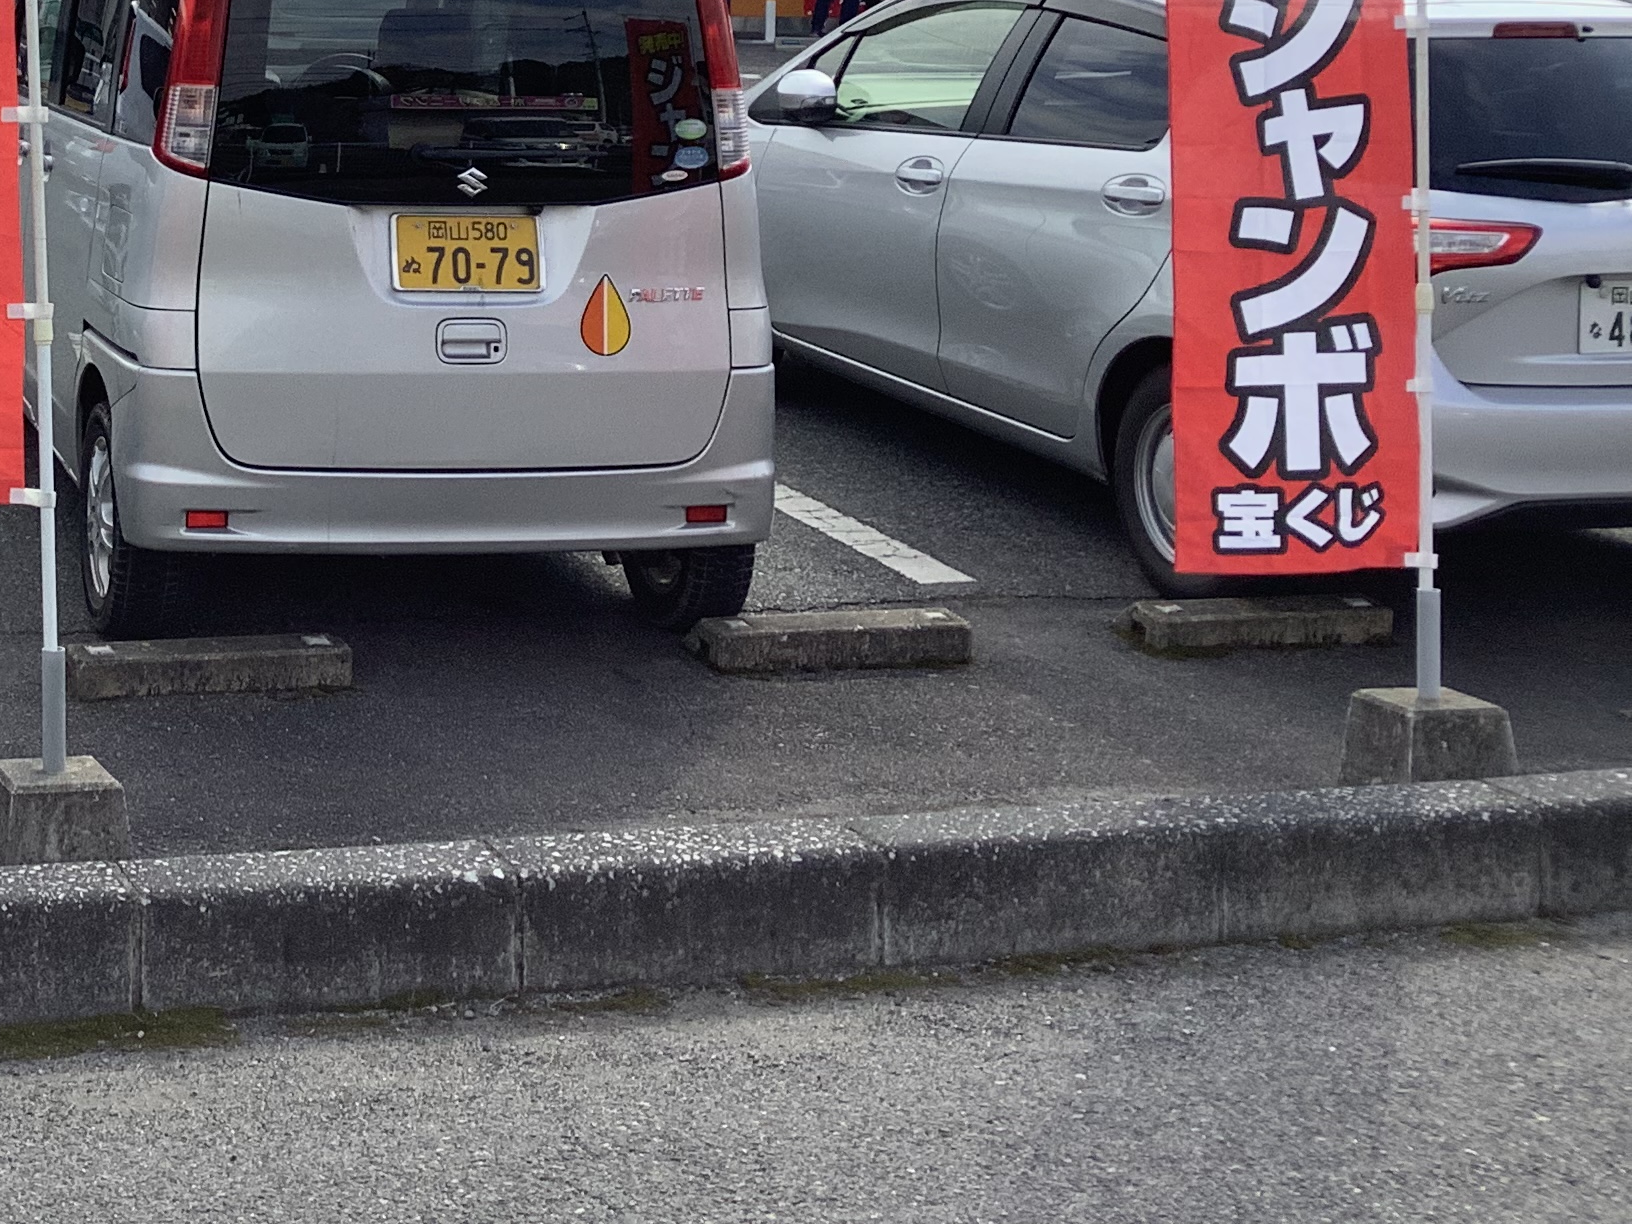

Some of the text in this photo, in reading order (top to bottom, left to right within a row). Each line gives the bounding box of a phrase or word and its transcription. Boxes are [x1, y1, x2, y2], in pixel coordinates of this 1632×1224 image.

[402, 246, 536, 286] ぬ 70-79
[1611, 286, 1632, 306] 岡
[1608, 310, 1632, 348] 4
[1216, 486, 1381, 550] 宝くじ
